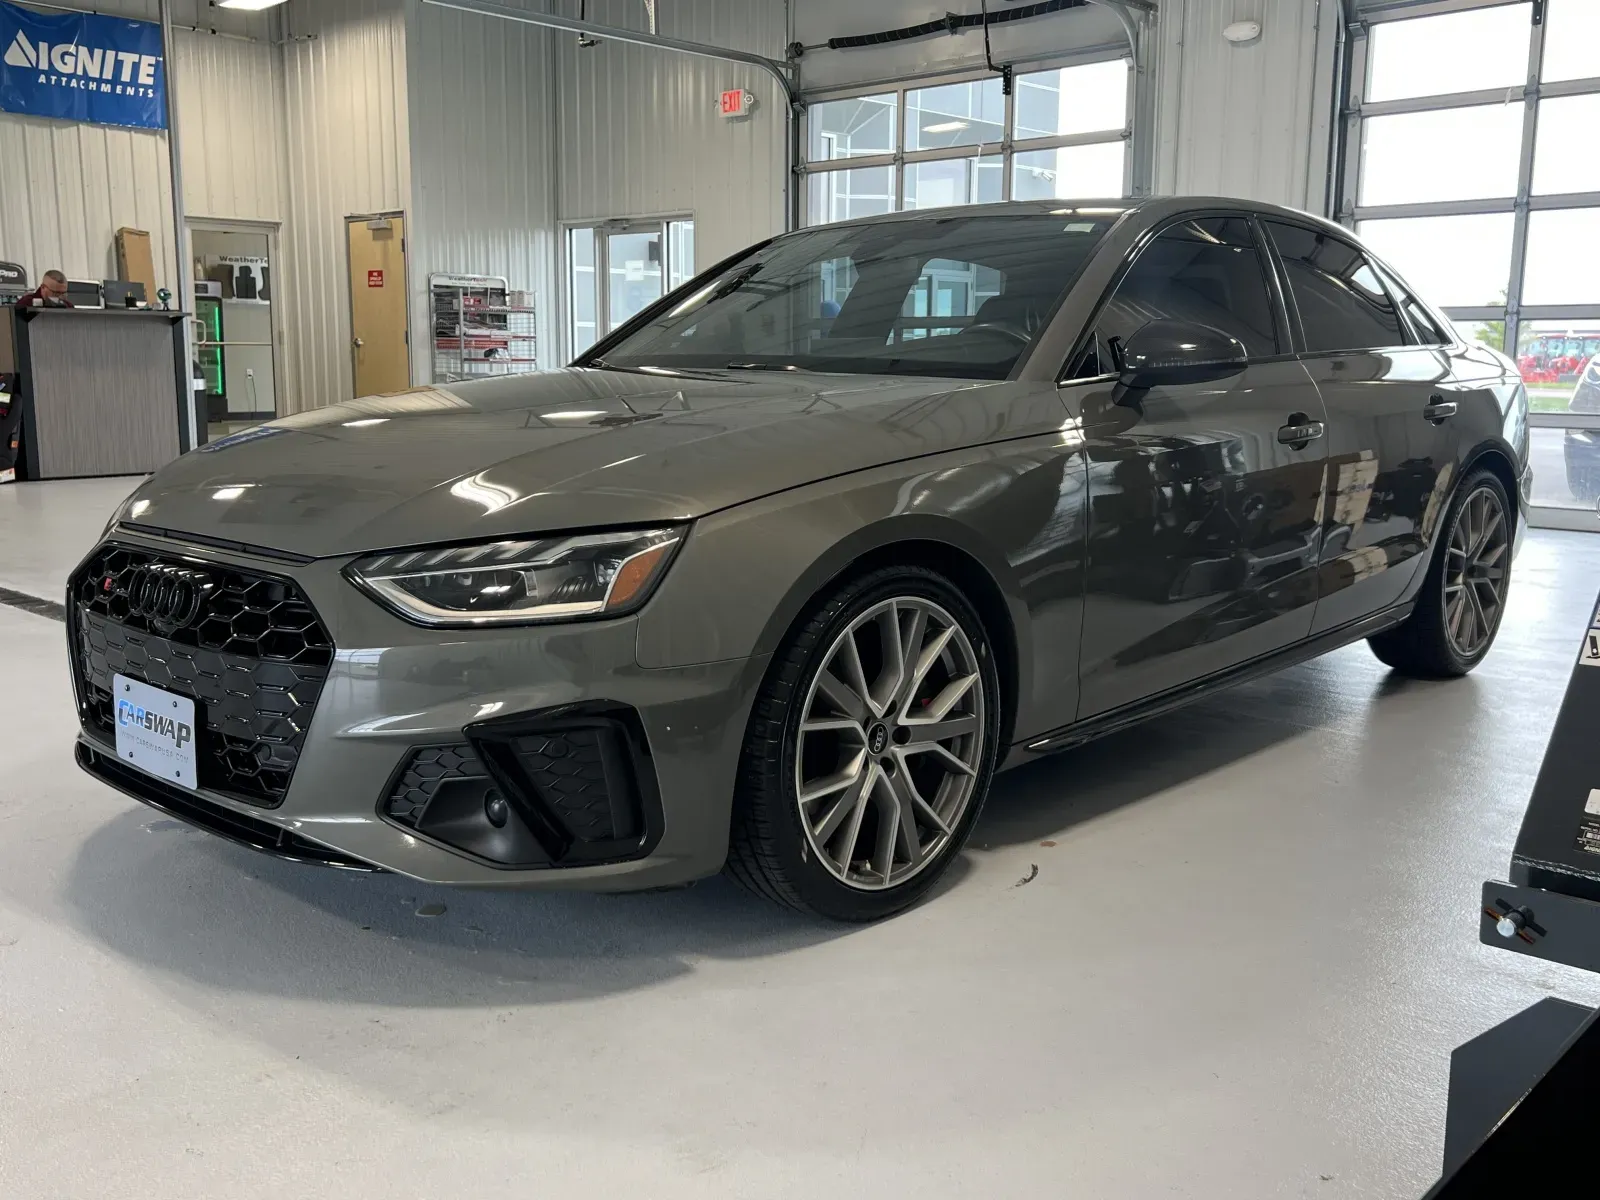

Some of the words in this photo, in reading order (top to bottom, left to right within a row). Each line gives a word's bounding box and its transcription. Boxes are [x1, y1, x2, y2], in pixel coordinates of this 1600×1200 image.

[38, 41, 156, 85] IGNITE
[38, 74, 154, 98] ATTACHMENTS
[723, 90, 740, 112] EXIT
[119, 699, 191, 749] CARSWAP
